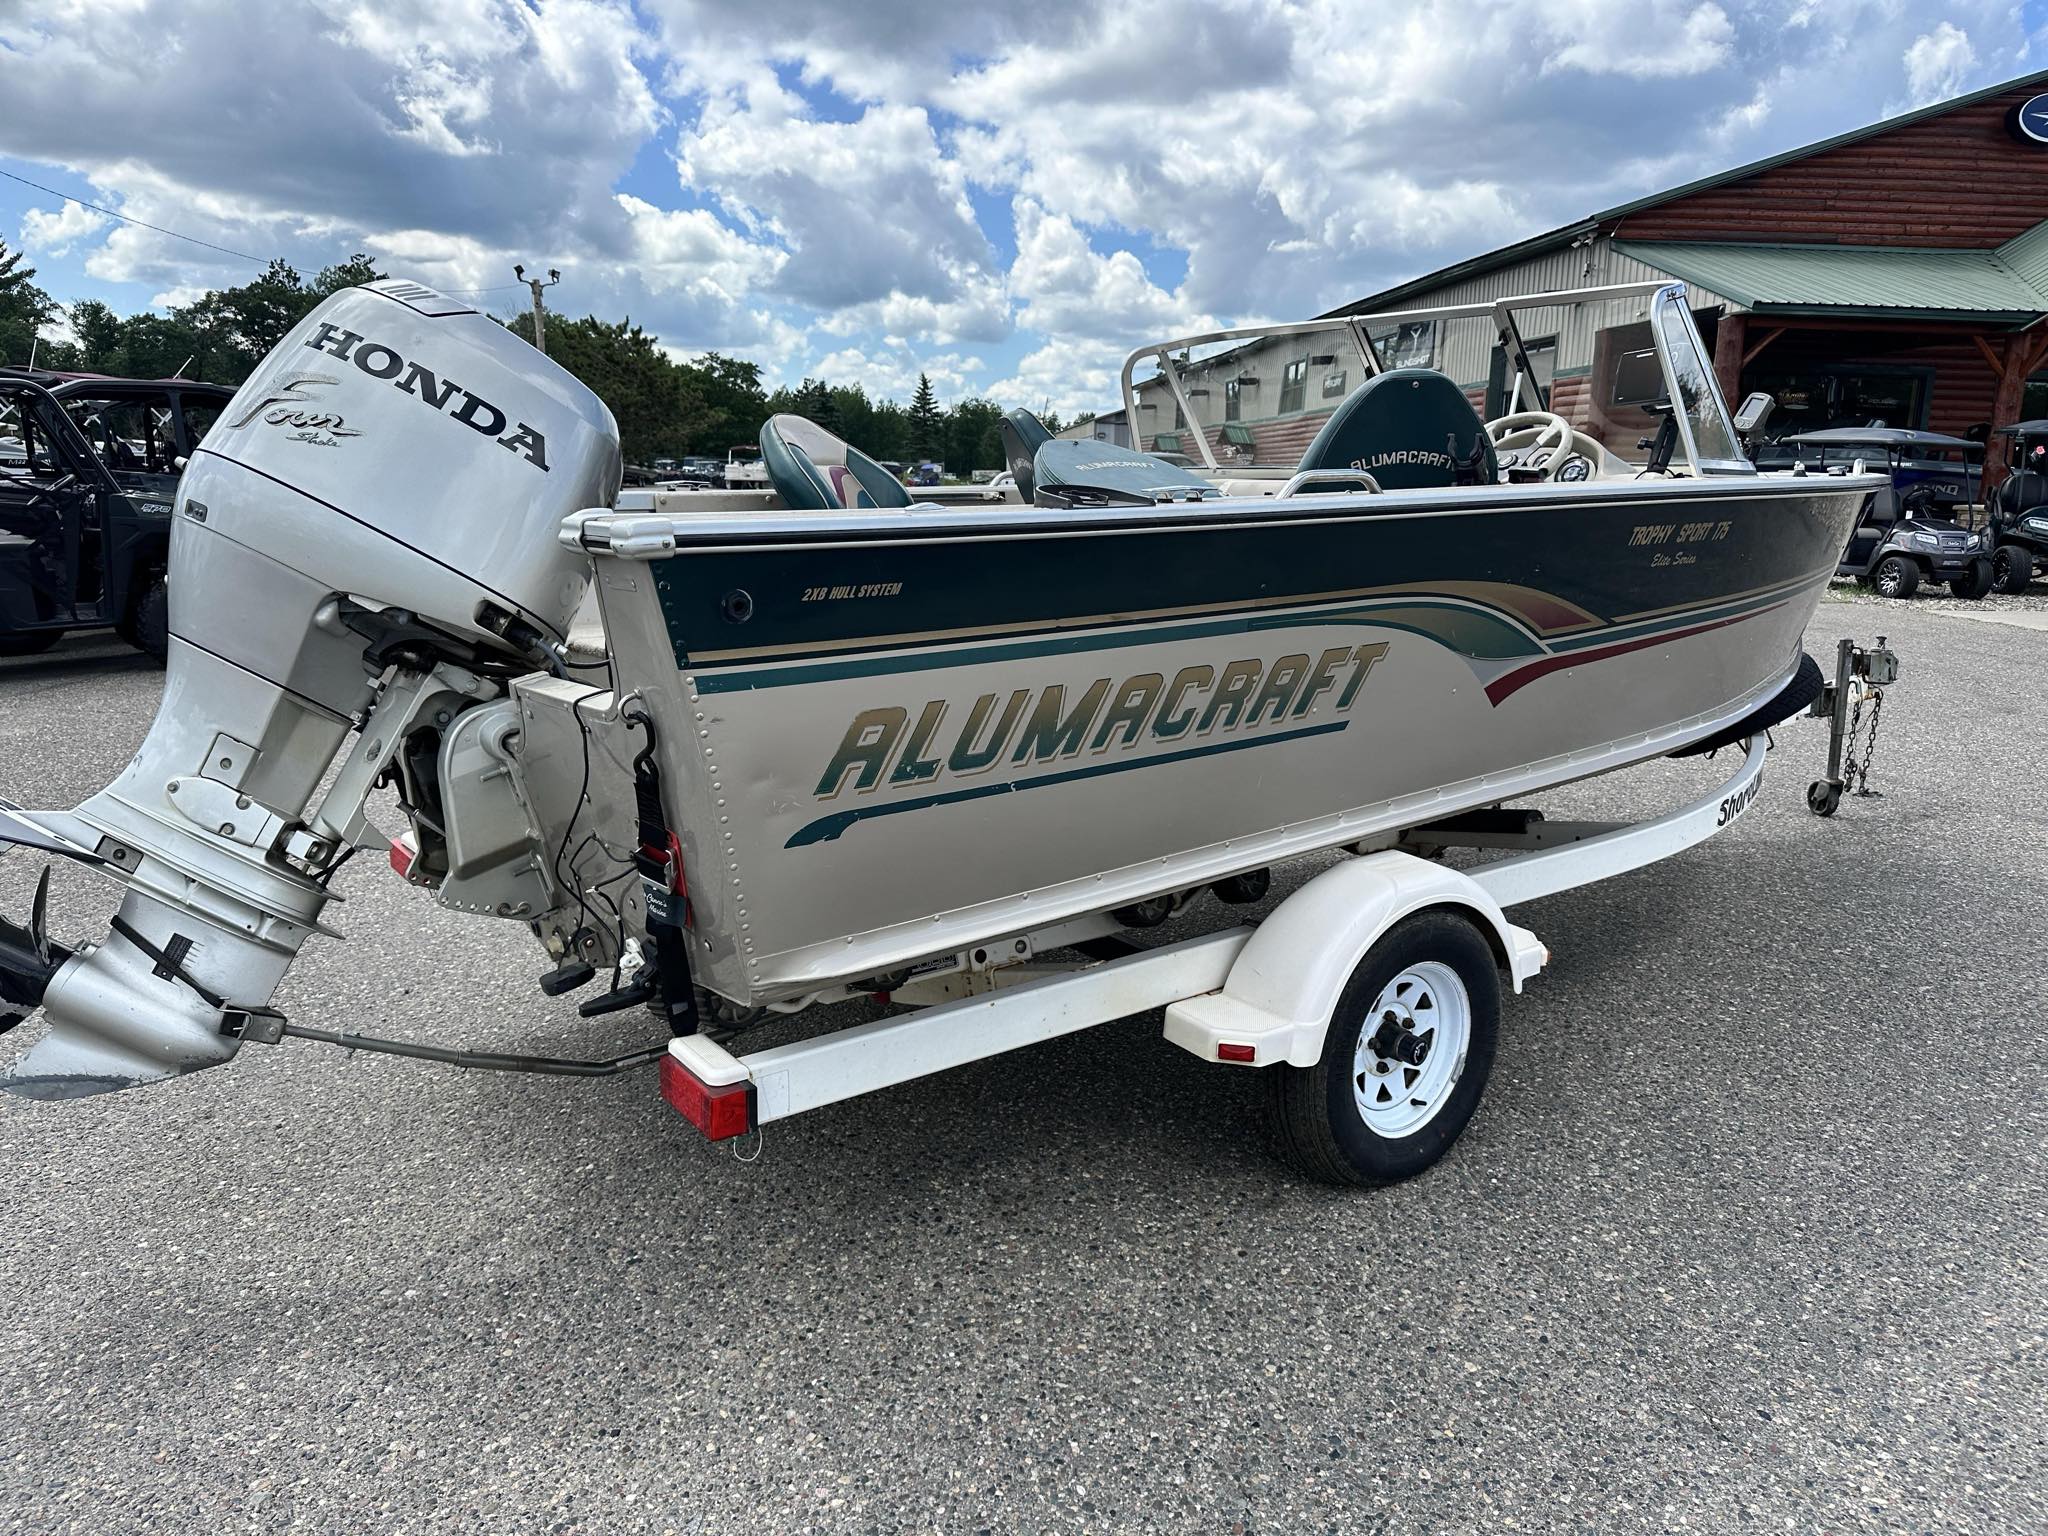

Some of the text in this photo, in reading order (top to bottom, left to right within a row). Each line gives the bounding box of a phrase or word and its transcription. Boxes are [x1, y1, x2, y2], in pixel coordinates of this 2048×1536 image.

[227, 371, 366, 437] Four
[304, 322, 551, 473] HONDA
[1074, 461, 1156, 472] ALUMACRAFT
[1628, 521, 1733, 546] TROPHY SPORT 175
[1650, 552, 1697, 568] Elite Series
[828, 585, 857, 600] HULL
[857, 582, 903, 598] SYSTEM
[813, 642, 1390, 801] ALUMACRAFT
